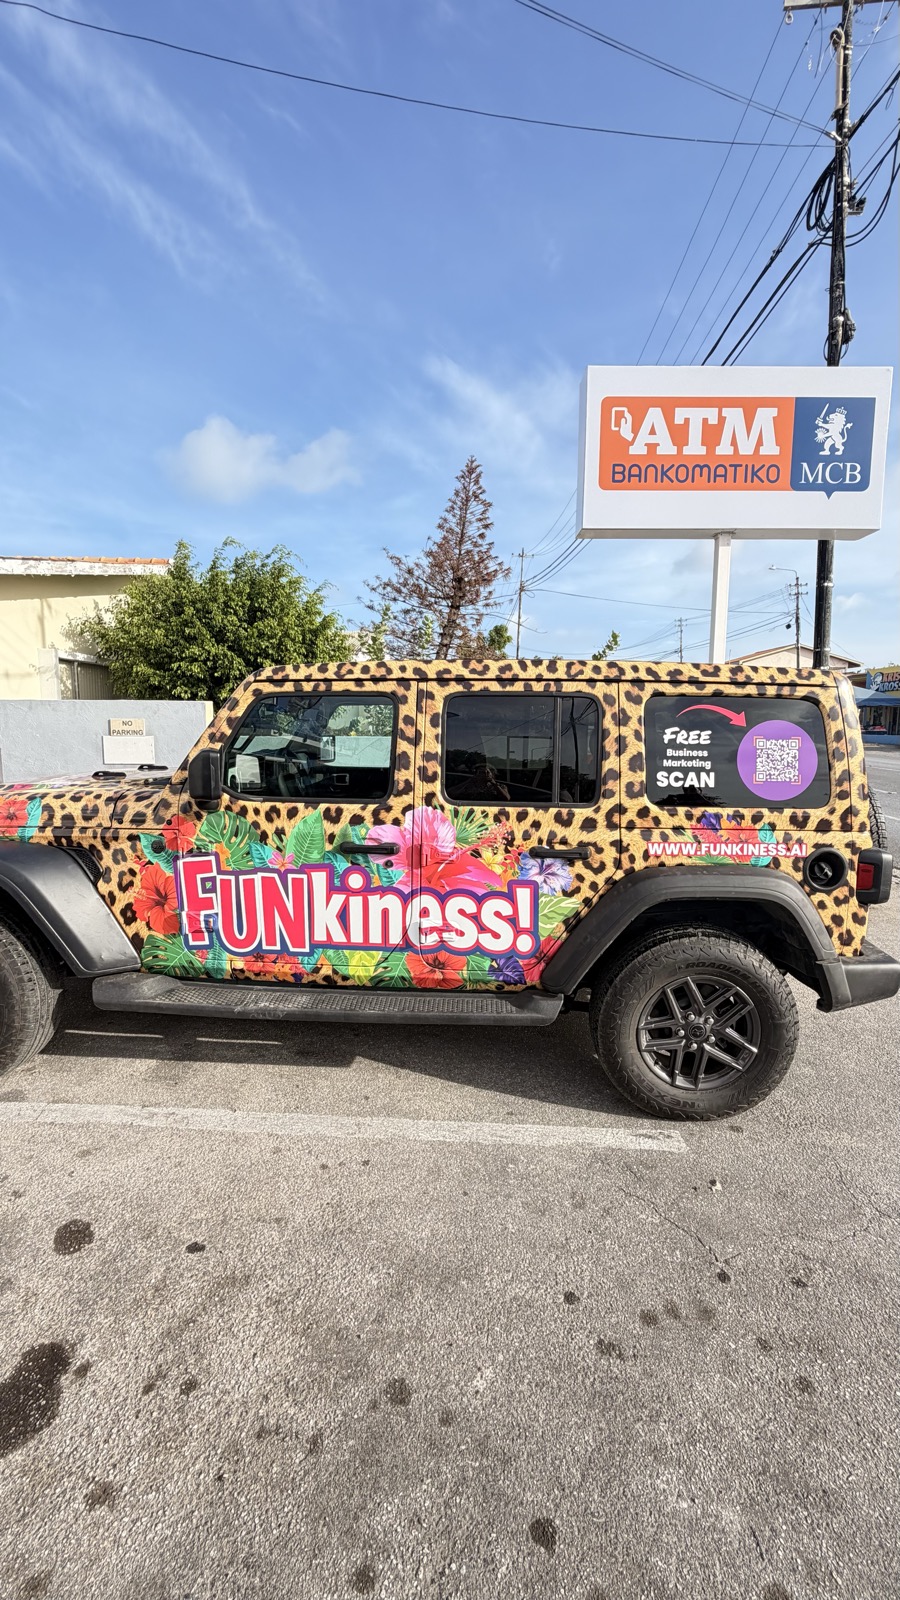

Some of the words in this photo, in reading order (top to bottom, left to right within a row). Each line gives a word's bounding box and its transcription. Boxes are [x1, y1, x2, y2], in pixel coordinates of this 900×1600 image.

[628, 407, 780, 456] ATM
[611, 463, 781, 484] BANKOMATIKO
[799, 462, 862, 485] MCB
[878, 681, 900, 692] KROS
[662, 726, 712, 745] FREE
[666, 748, 709, 758] Business
[662, 758, 712, 770] Marketing
[656, 771, 715, 788] SCAN
[648, 842, 808, 857] WWW.FUNKINESS.AI
[178, 855, 537, 954] FUNkiness!
